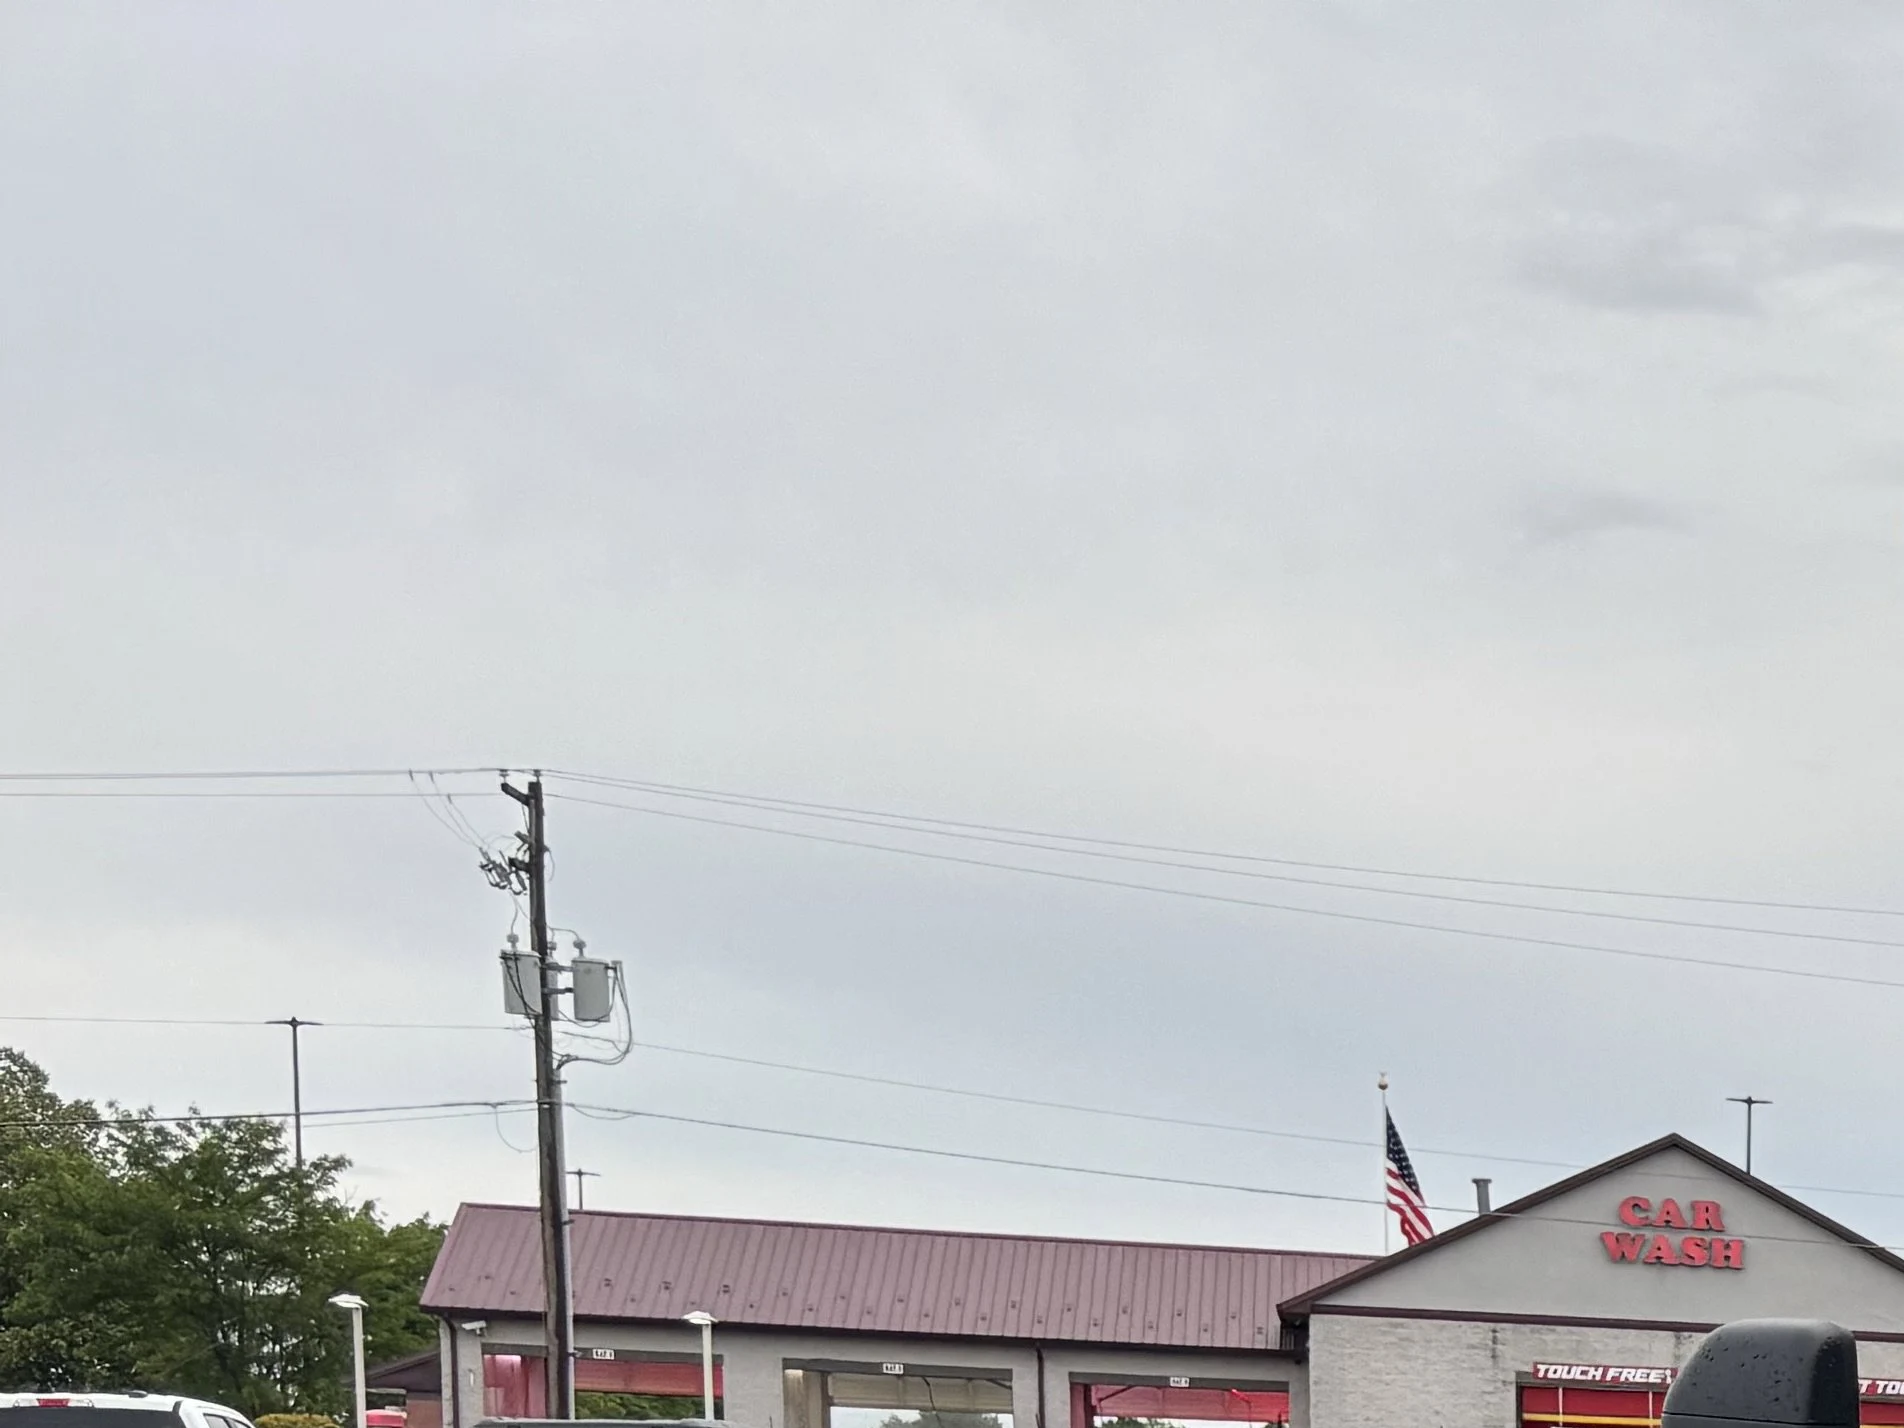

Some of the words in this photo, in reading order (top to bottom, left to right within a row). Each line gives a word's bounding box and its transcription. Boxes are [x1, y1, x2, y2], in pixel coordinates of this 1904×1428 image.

[1619, 1196, 1725, 1232] CAR
[1600, 1232, 1744, 1270] WASH
[1537, 1364, 1603, 1381] TOUCH
[1605, 1367, 1662, 1384] FREE
